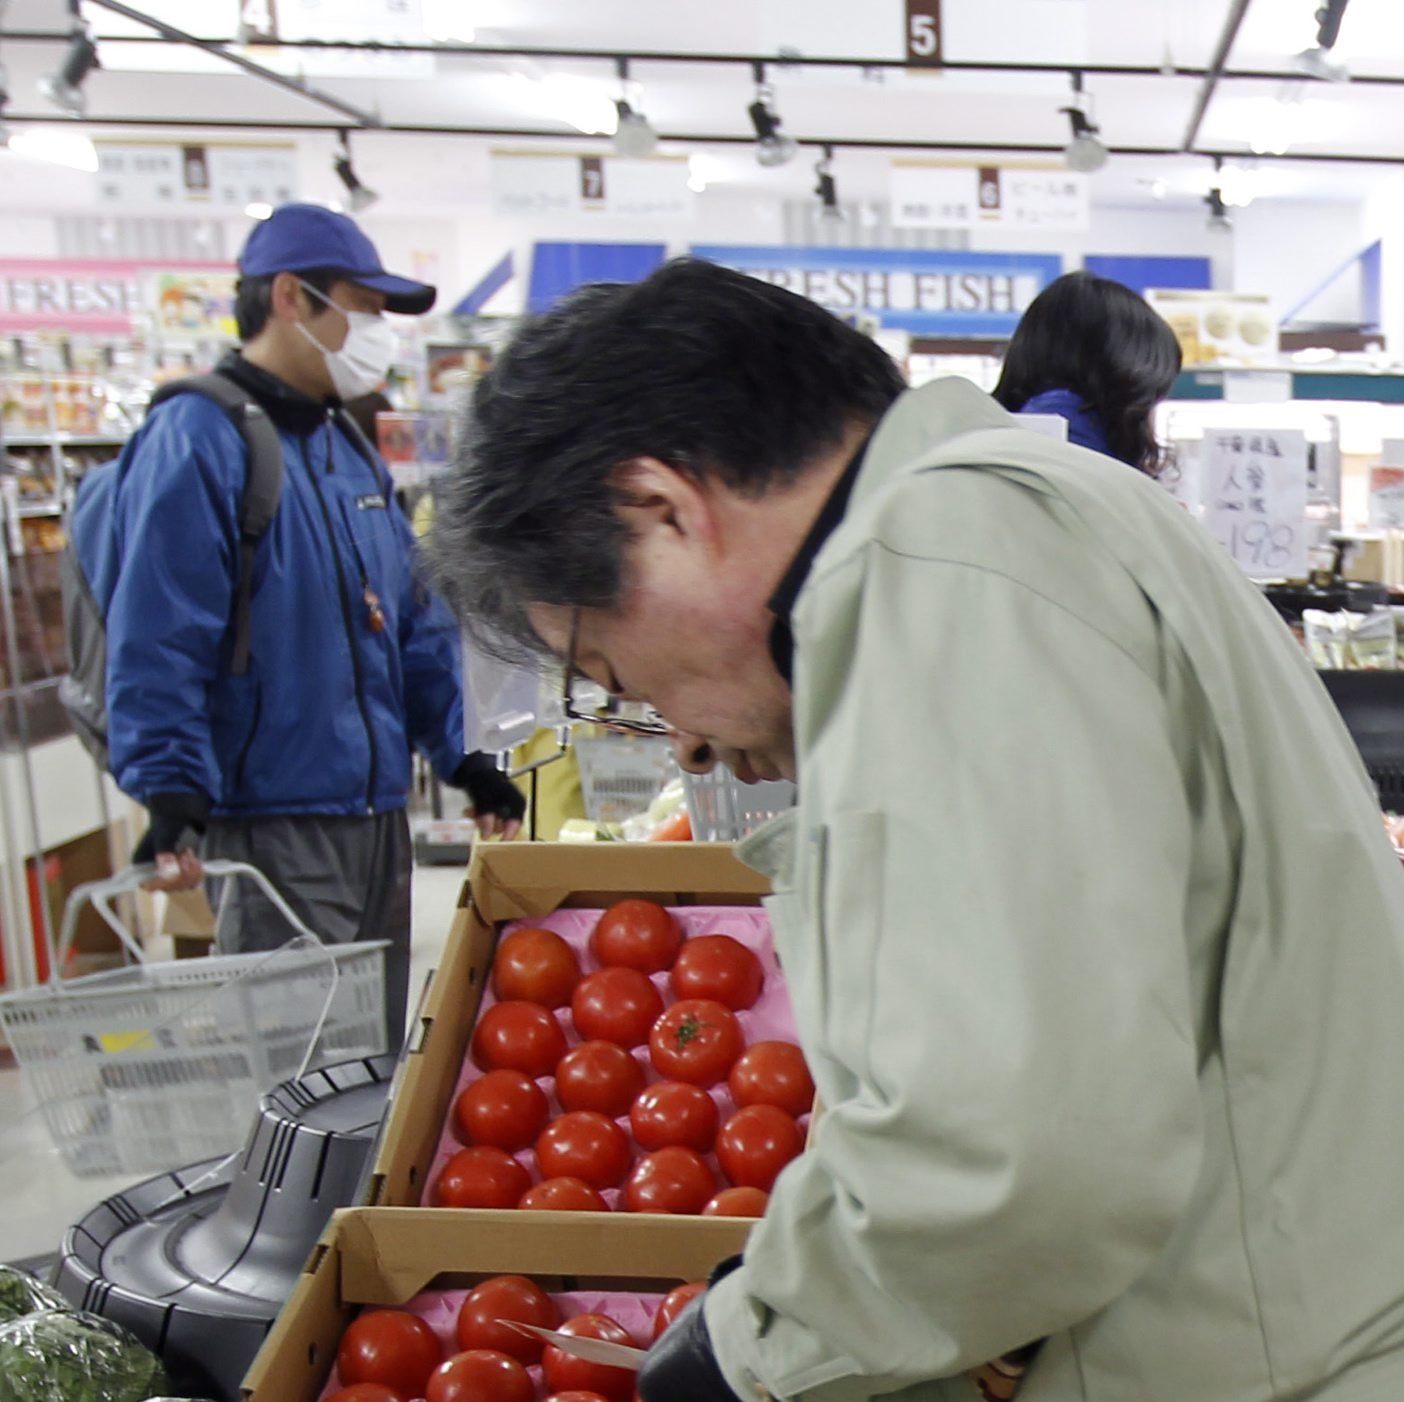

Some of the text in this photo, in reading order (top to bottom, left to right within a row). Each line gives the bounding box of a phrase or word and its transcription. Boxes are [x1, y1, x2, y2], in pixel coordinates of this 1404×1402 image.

[911, 14, 936, 56] 5
[738, 267, 1018, 313] RESH FISH
